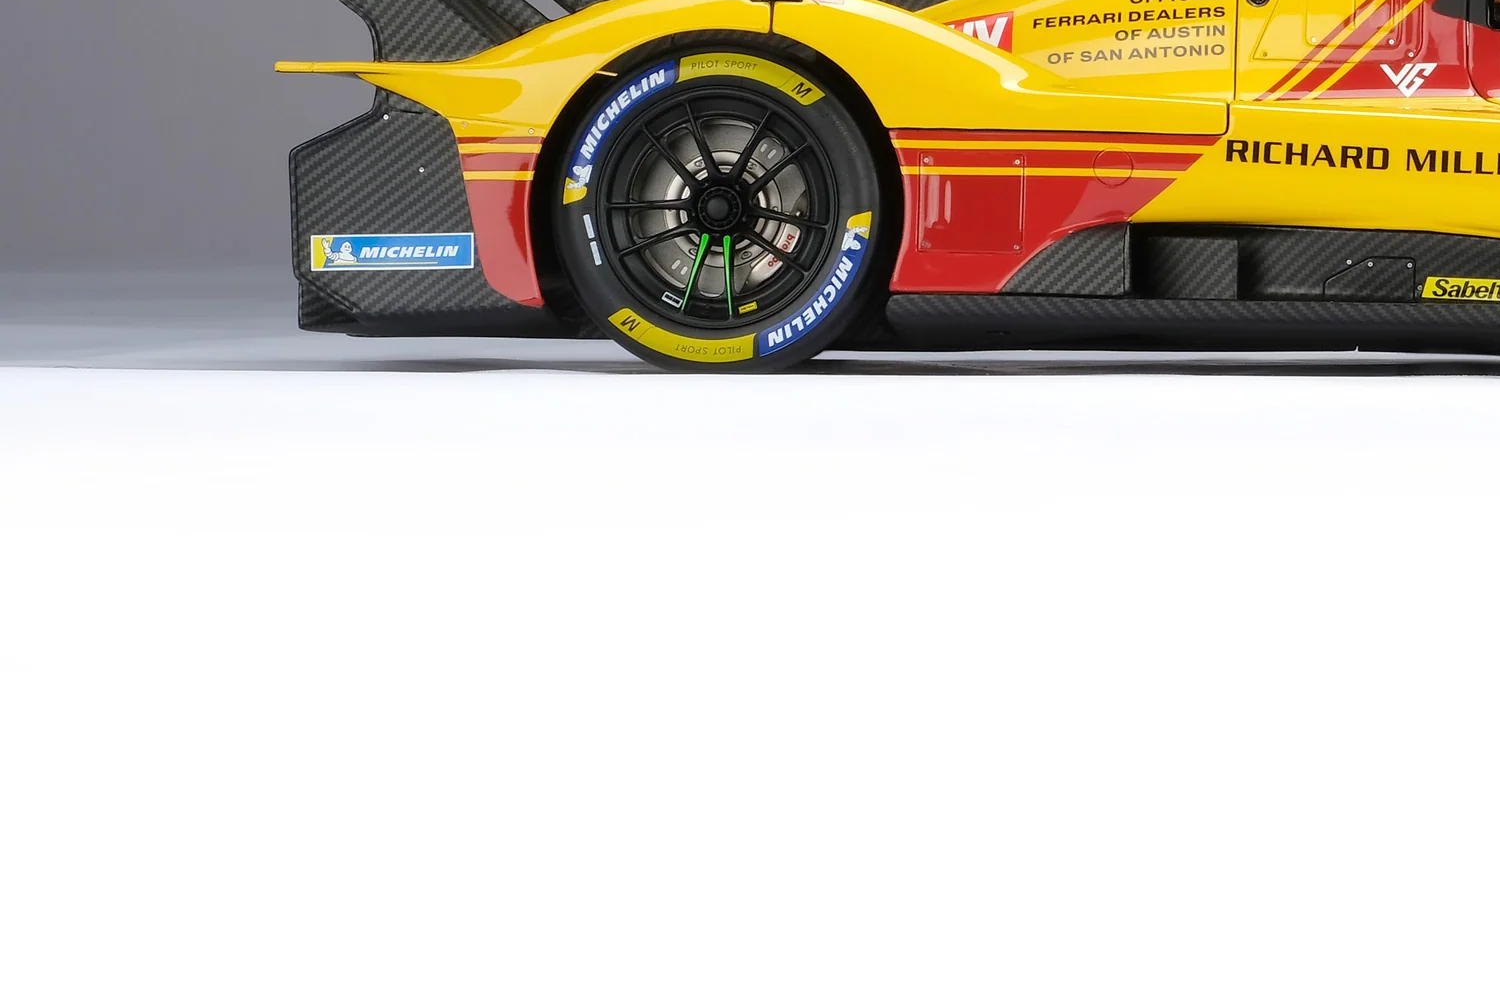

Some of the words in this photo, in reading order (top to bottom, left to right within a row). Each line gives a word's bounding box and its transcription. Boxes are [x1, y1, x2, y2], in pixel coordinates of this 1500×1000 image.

[1032, 12, 1122, 29] FERRARI
[1128, 6, 1226, 22] DEALERS
[1114, 29, 1142, 42] OF
[1147, 25, 1226, 40] AUSTIN
[1047, 52, 1074, 65] OF
[1080, 49, 1123, 63] SAN
[1128, 44, 1225, 60] ANTONIO
[690, 60, 719, 70] PILOT
[724, 59, 757, 72] SPORT
[791, 81, 813, 99] M
[580, 68, 665, 160] MICHELIN
[1225, 139, 1389, 170] RICHARD
[359, 245, 459, 259] MICHELIN
[767, 255, 853, 348] MICHELIN
[620, 314, 641, 333] M
[675, 343, 708, 355] SPORT
[713, 344, 741, 354] PILOT
